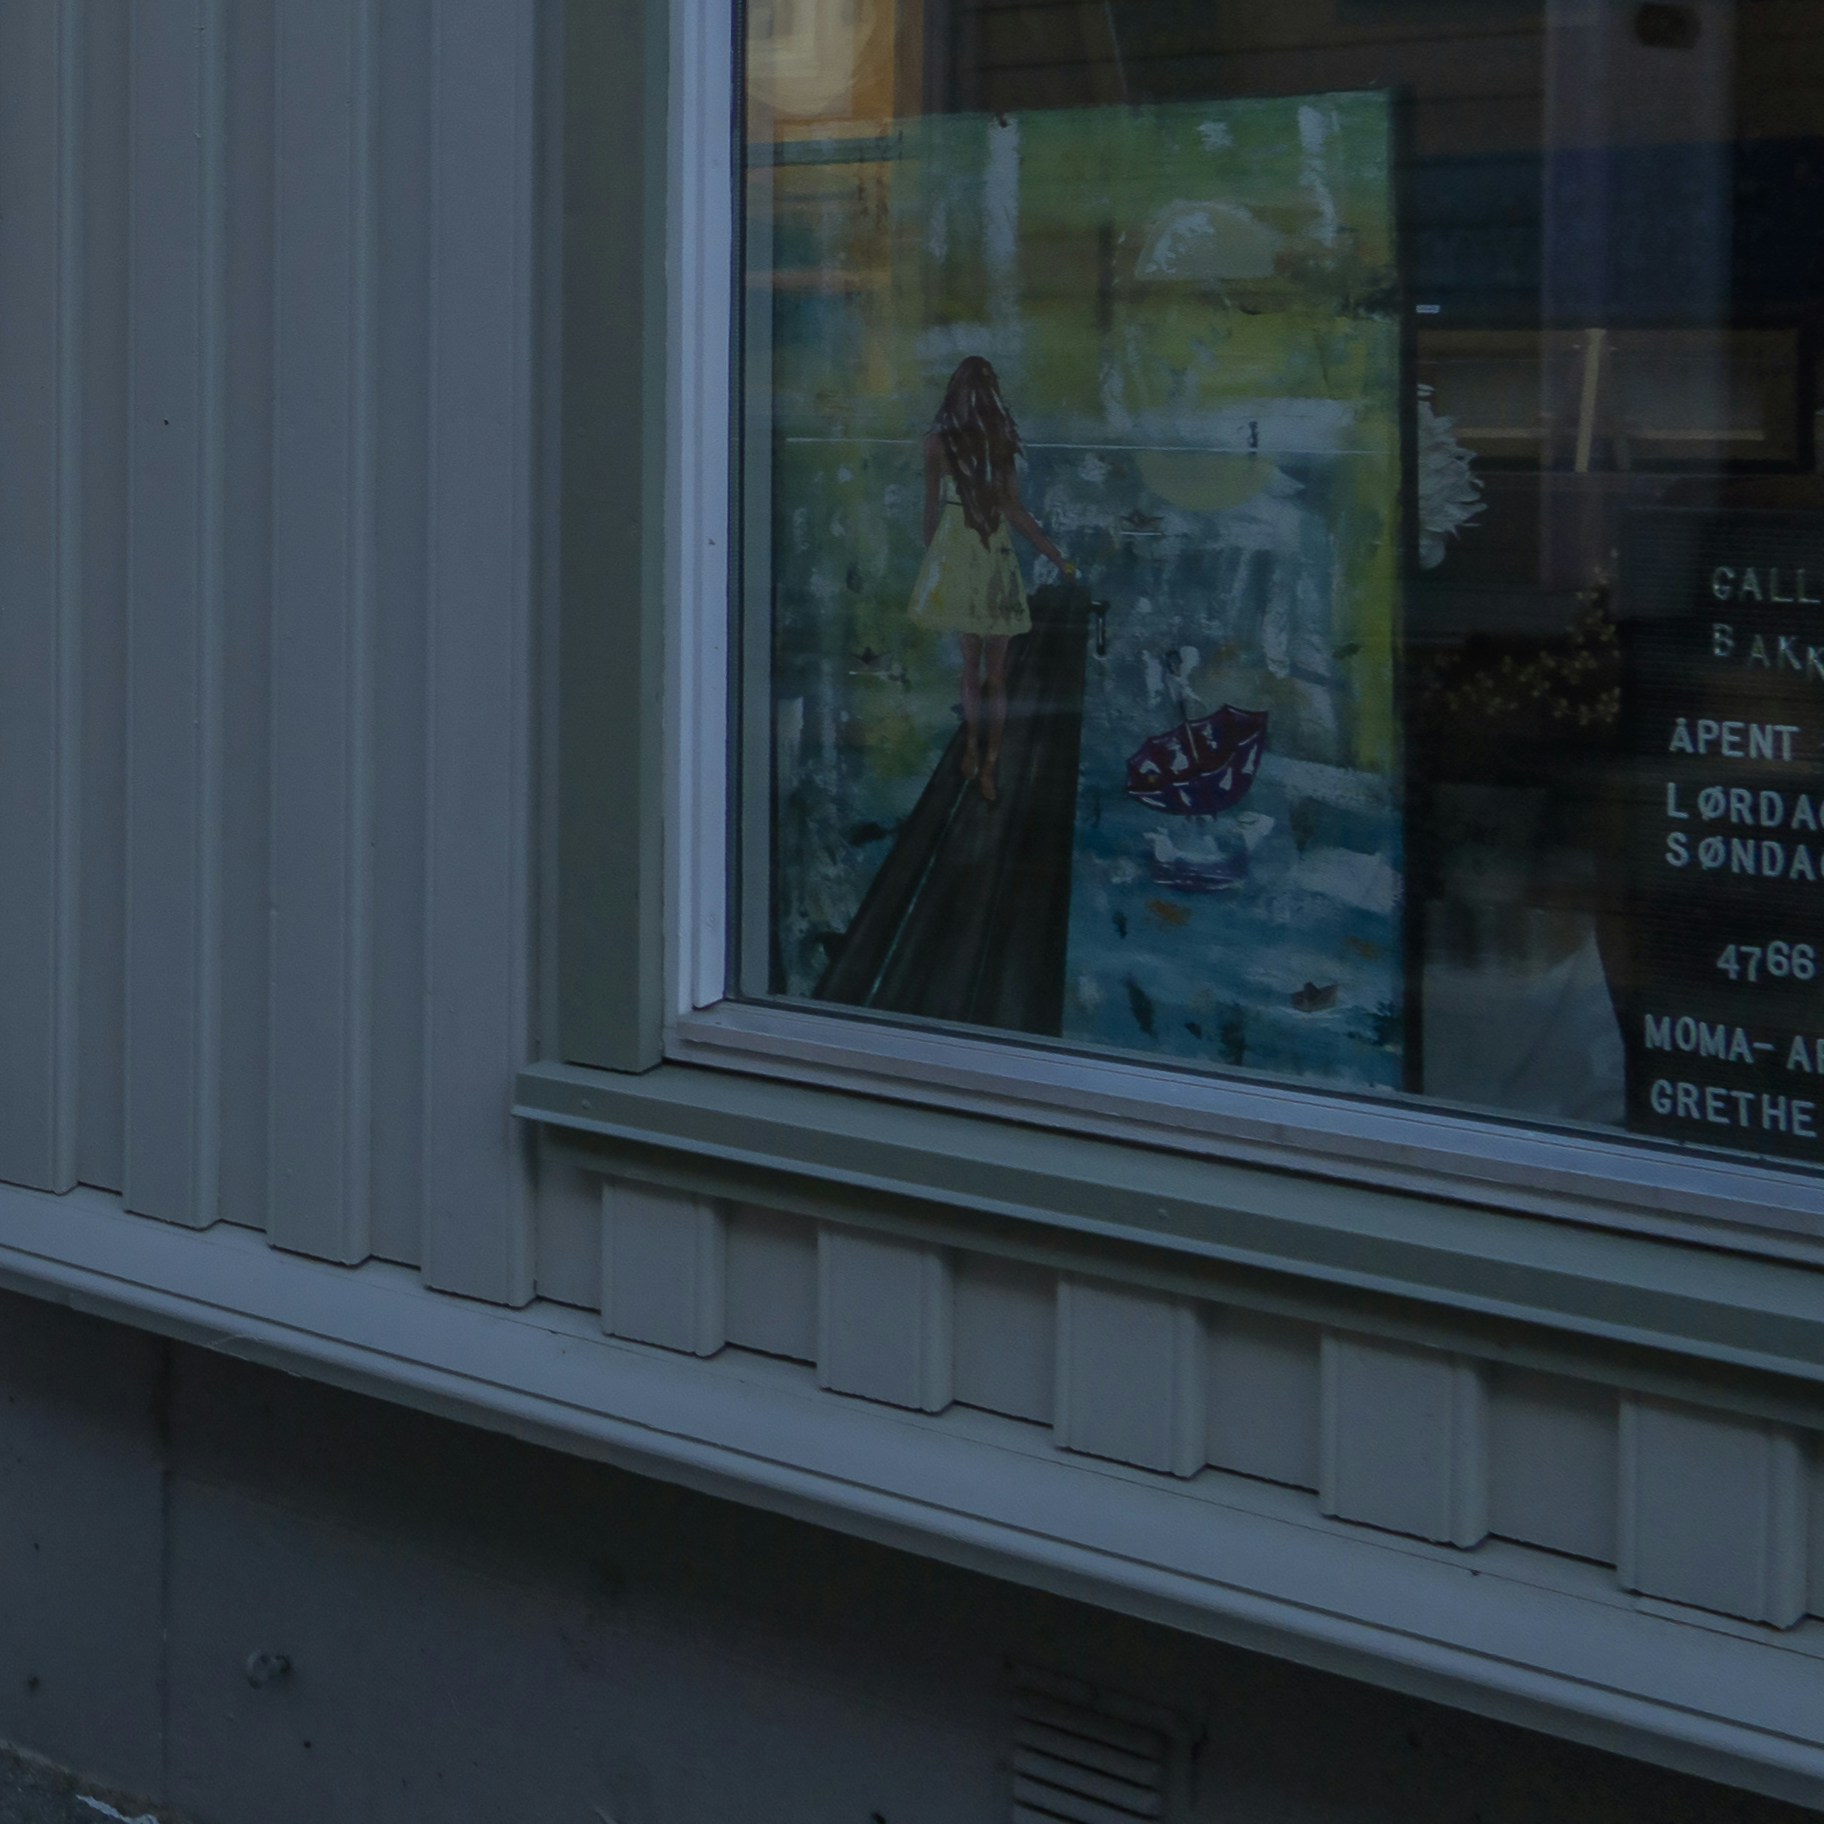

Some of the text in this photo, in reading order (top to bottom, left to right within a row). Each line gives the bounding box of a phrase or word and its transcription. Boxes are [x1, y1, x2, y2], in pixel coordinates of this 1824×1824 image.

[1712, 566, 1822, 605] GALL
[1668, 717, 1801, 763] ÅPENT
[1666, 781, 1824, 832] LØRDA
[1665, 831, 1824, 882] SØNDA
[1715, 939, 1817, 983] 4766
[1650, 1078, 1818, 1138] GRETHE
